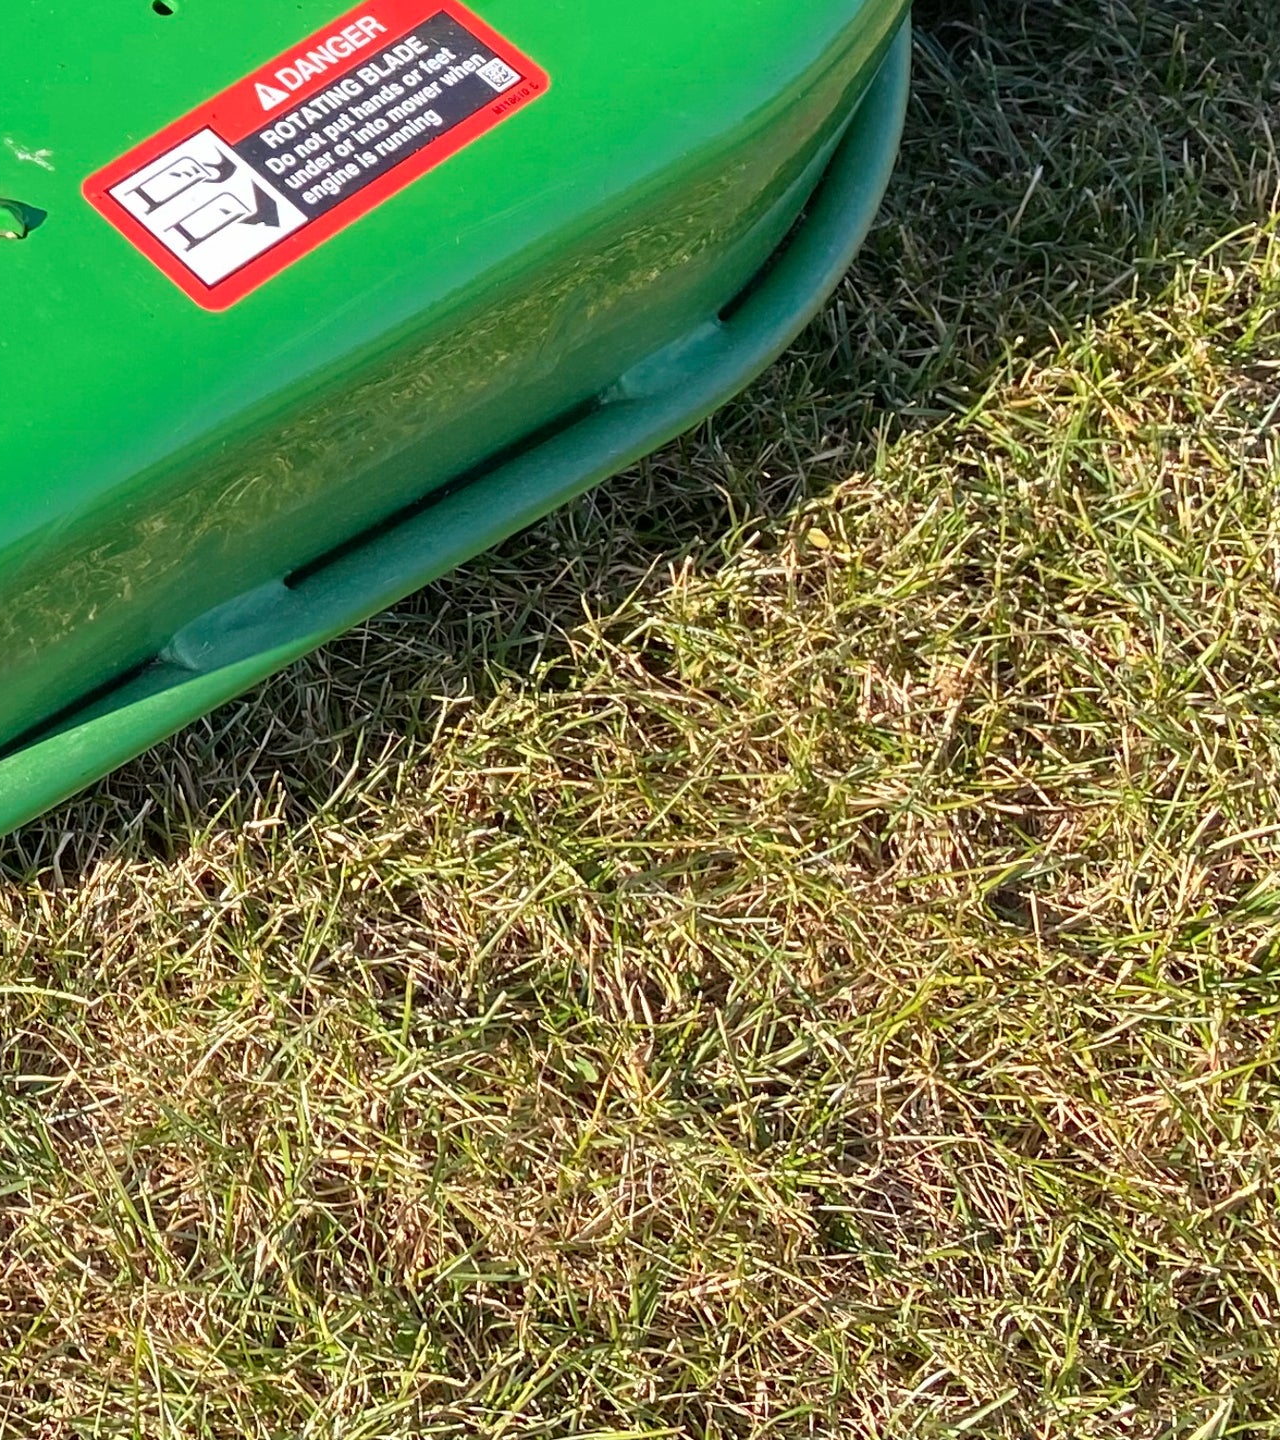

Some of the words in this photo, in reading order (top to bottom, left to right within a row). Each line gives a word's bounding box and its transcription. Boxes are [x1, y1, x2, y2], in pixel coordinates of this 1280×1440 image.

[259, 77, 364, 149] ROTATING
[357, 35, 429, 86] BLADE
[274, 15, 388, 91] DANGER
[265, 152, 296, 175] Do
[294, 130, 327, 159] not
[322, 112, 356, 142] put
[348, 82, 405, 122] hands
[402, 67, 426, 88] or
[418, 46, 457, 76] feet
[284, 151, 340, 190] under
[336, 139, 356, 159] or
[351, 116, 390, 146] into
[385, 82, 444, 124] mower
[439, 53, 488, 86] when
[302, 161, 363, 205] engine
[355, 149, 378, 169] is
[373, 108, 443, 158] running
